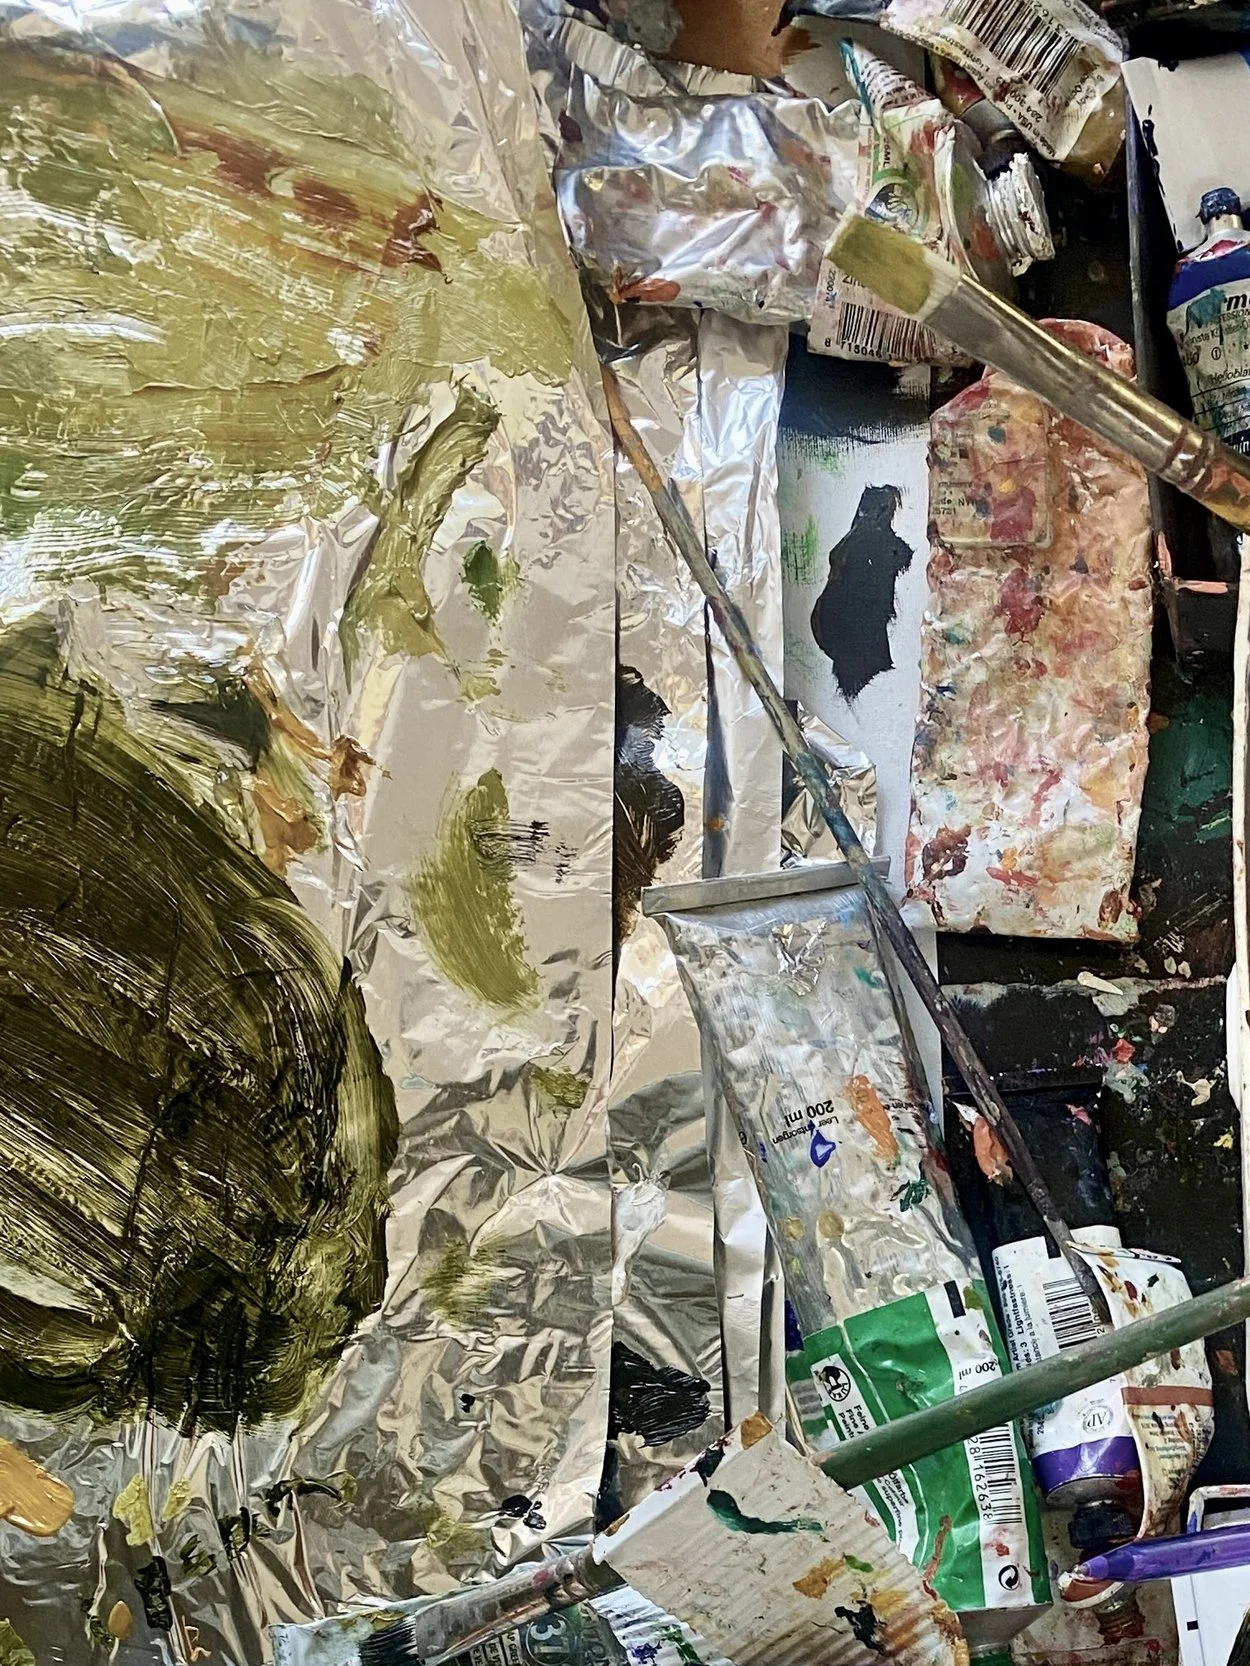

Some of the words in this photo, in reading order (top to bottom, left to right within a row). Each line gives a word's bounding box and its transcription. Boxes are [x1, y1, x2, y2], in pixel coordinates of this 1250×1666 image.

[805, 1098, 834, 1118] 200
[782, 1109, 803, 1127] ml
[957, 1366, 973, 1379] ml
[971, 1464, 995, 1521] 162638
